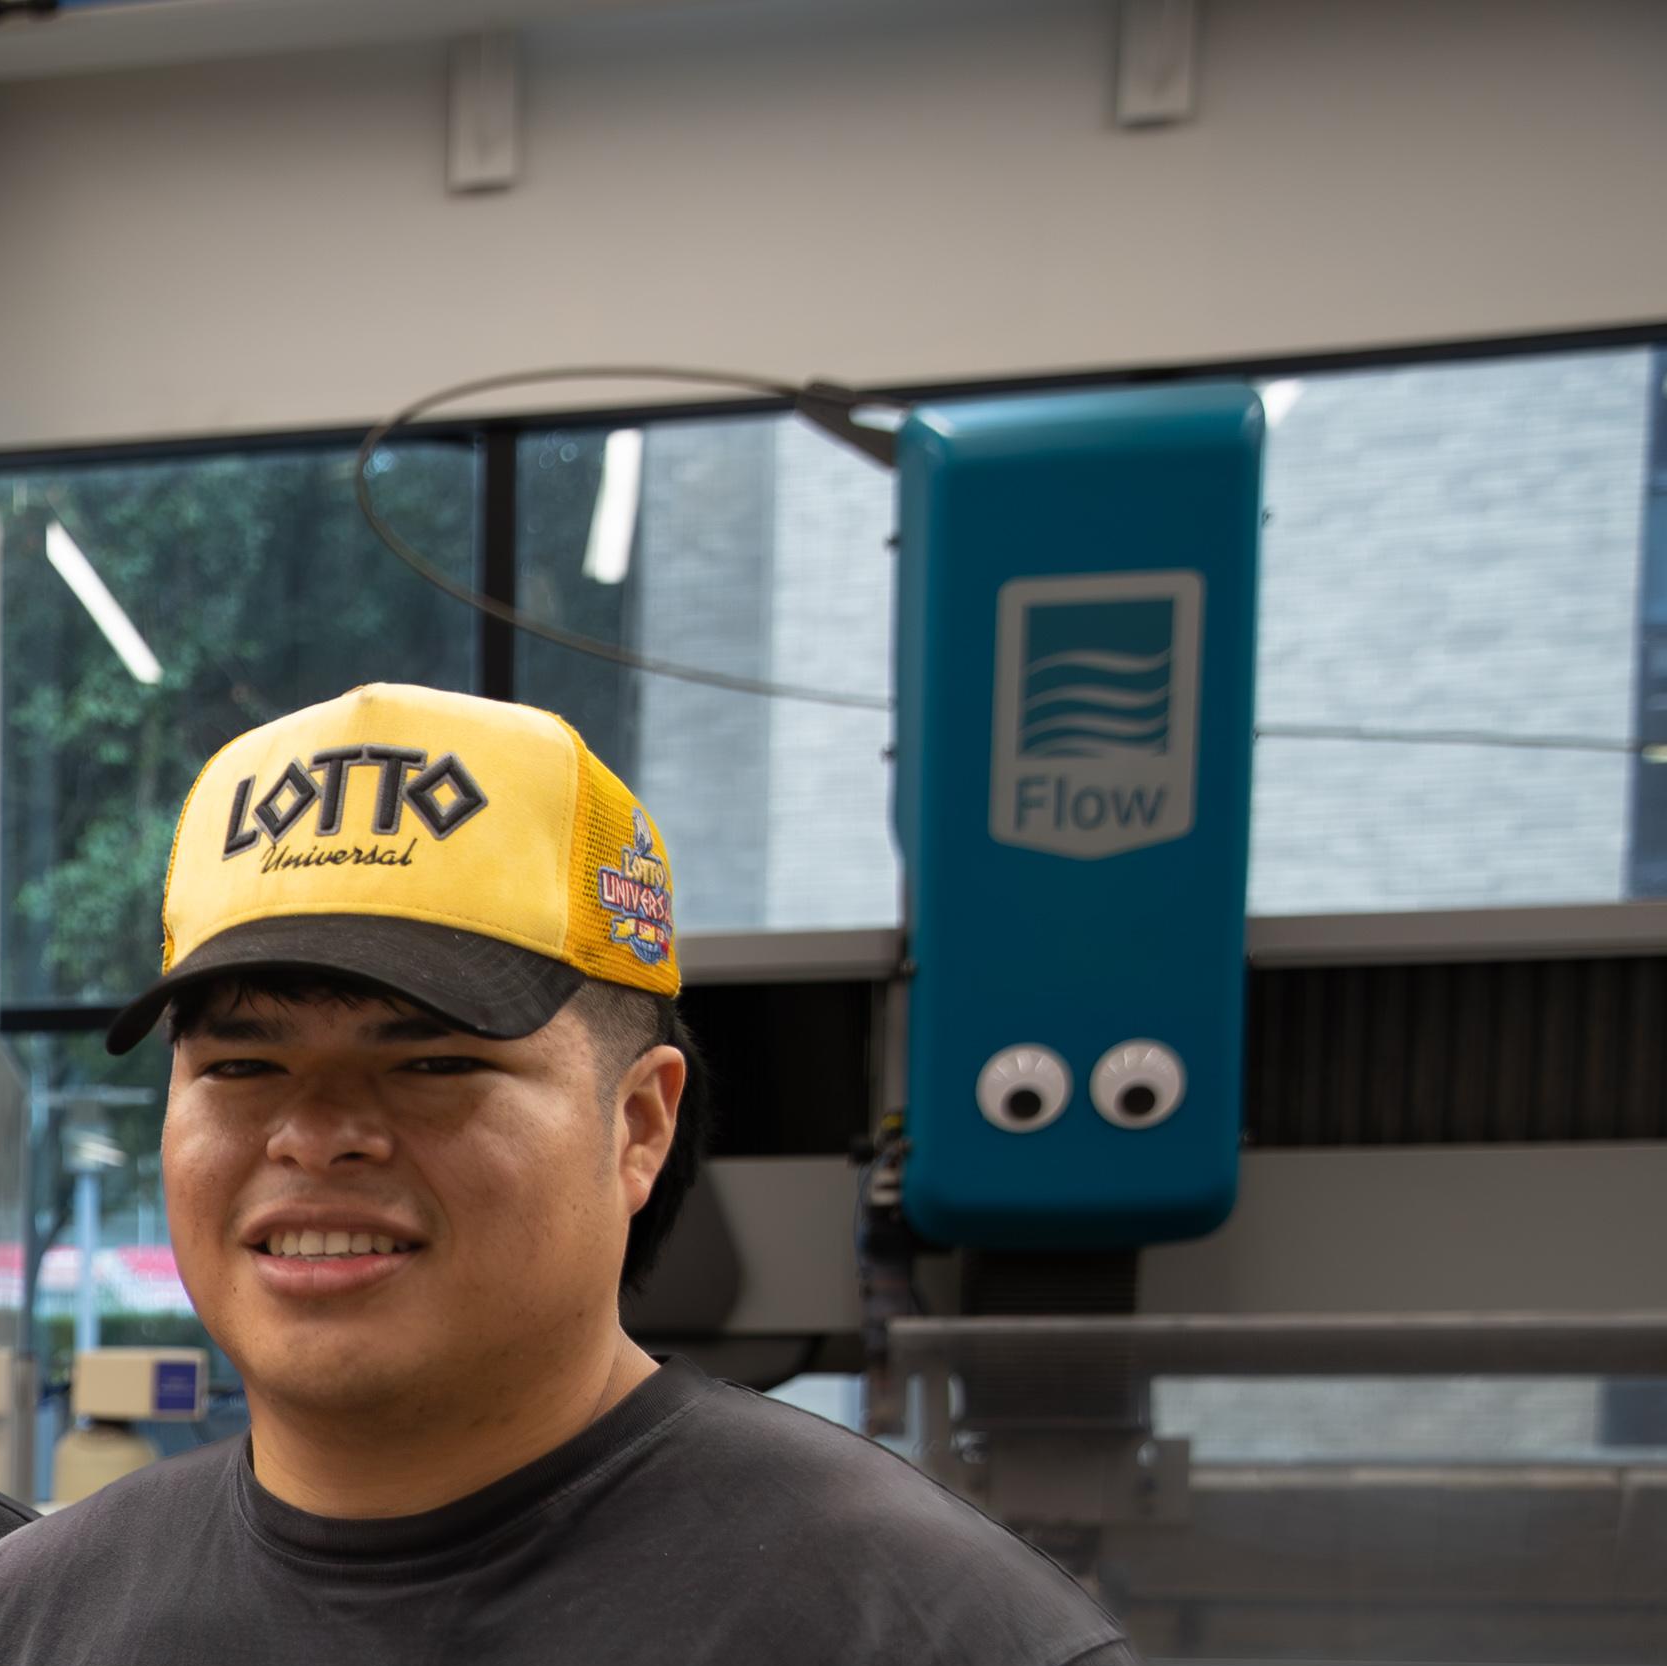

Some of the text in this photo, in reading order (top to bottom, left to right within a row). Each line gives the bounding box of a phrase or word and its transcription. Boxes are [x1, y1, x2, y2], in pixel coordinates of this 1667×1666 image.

[222, 743, 488, 862] LOTTO
[1014, 774, 1166, 833] Flow
[261, 838, 418, 874] Universal
[623, 851, 665, 888] LOTTO
